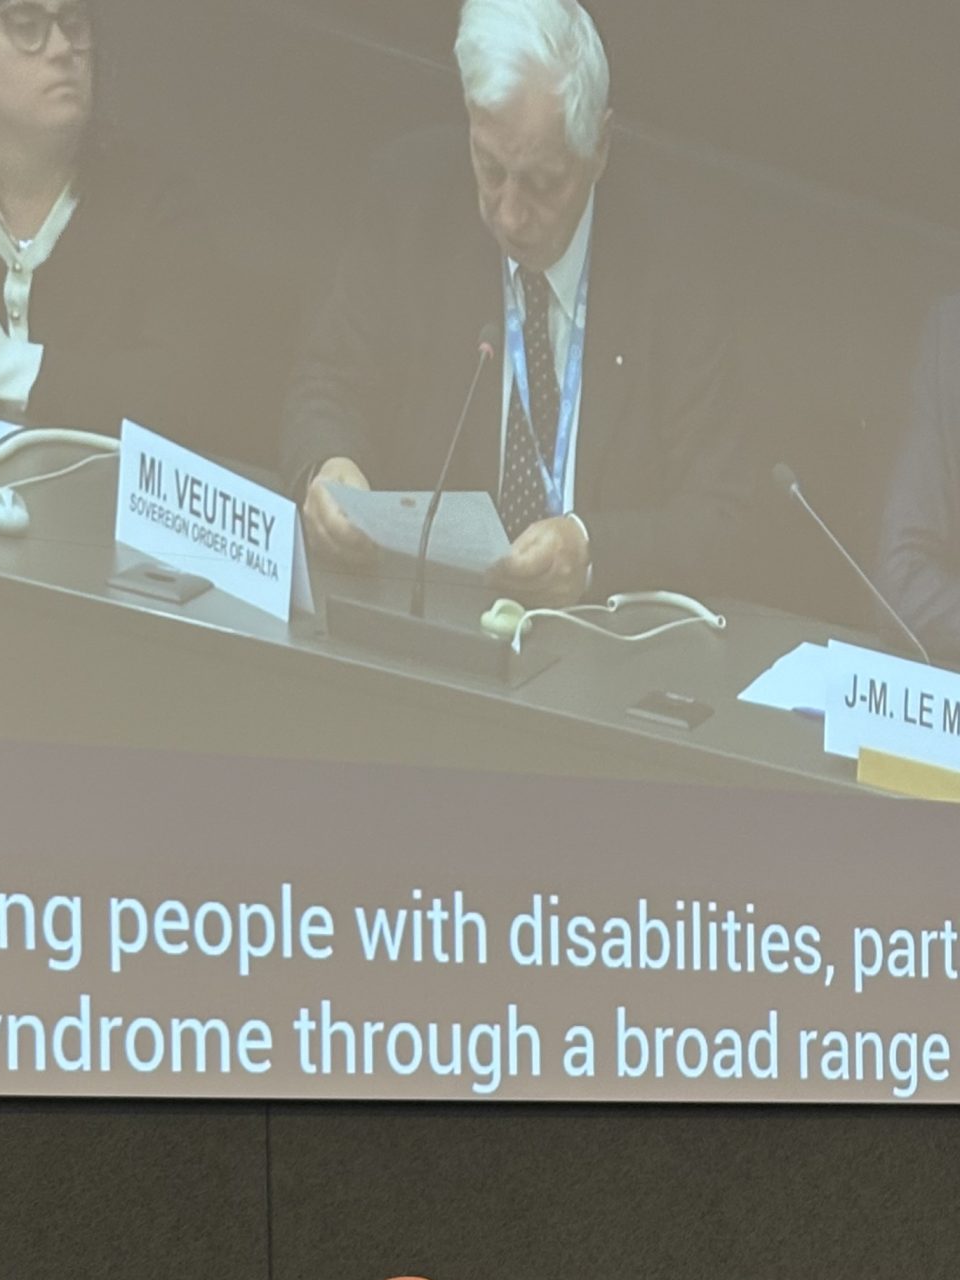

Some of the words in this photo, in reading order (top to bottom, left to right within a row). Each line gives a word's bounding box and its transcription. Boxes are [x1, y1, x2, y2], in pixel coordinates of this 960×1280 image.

[129, 492, 190, 538] SOVEREIGN
[191, 523, 228, 557] ORDER
[229, 541, 245, 565] OF
[246, 548, 279, 582] MALTA
[139, 451, 168, 501] MI.
[175, 468, 276, 552] VEUTHEY
[844, 673, 895, 720] J-M.
[903, 687, 935, 729] LE
[110, 883, 334, 977] people
[354, 888, 487, 963] with
[509, 893, 835, 987] disabilities,
[854, 919, 959, 994] part
[292, 999, 541, 1095] through
[563, 1025, 595, 1077] a
[617, 1006, 779, 1080] broad
[799, 1030, 952, 1098] range
